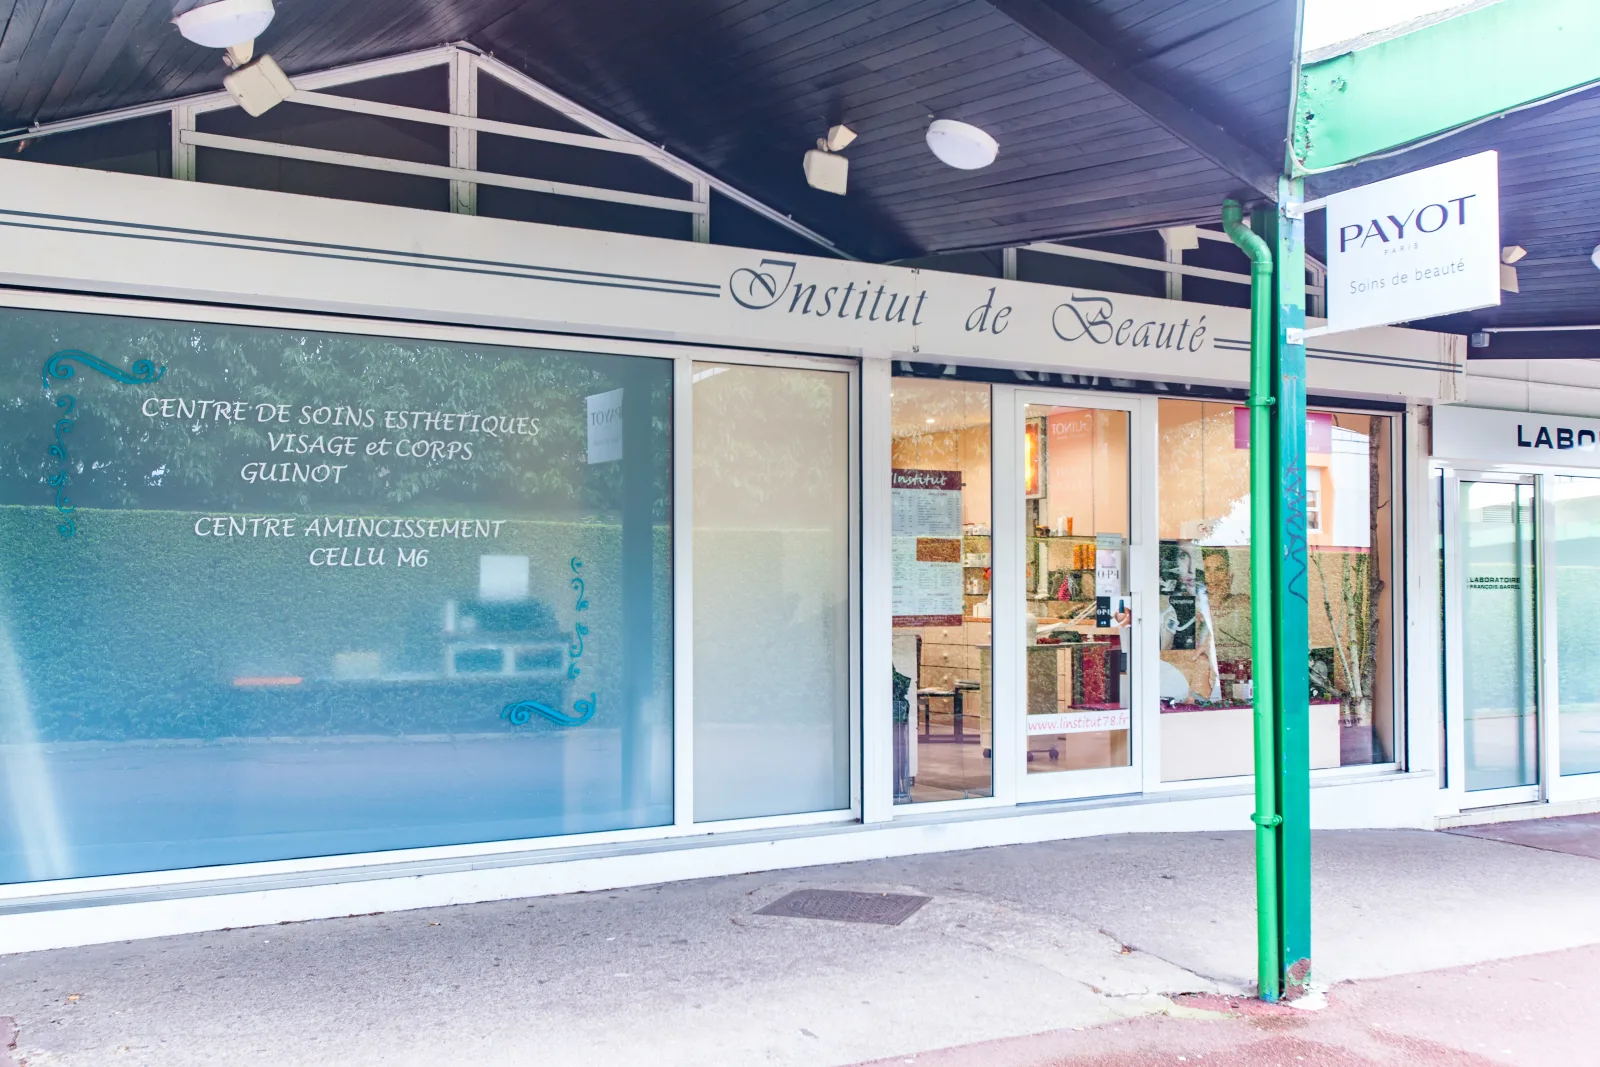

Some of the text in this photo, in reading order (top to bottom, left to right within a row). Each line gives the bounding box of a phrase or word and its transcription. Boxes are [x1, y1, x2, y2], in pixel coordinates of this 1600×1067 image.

[1340, 193, 1476, 253] PAYOT
[1384, 242, 1419, 255] PARIS
[1350, 257, 1466, 295] Soins de beauté
[729, 258, 1207, 353] Institut de Beauté
[142, 397, 540, 437] CENTRE DE SOINS ESTHETIQUES
[267, 432, 473, 461] VISAGE et CORPS
[1517, 424, 1600, 449] LABO
[241, 462, 348, 484] GUINOT
[194, 517, 506, 538] CENTRE AMINCISSEMENT
[309, 547, 429, 567] CELLU M6
[1028, 713, 1129, 731] www.linstitut78.fr
